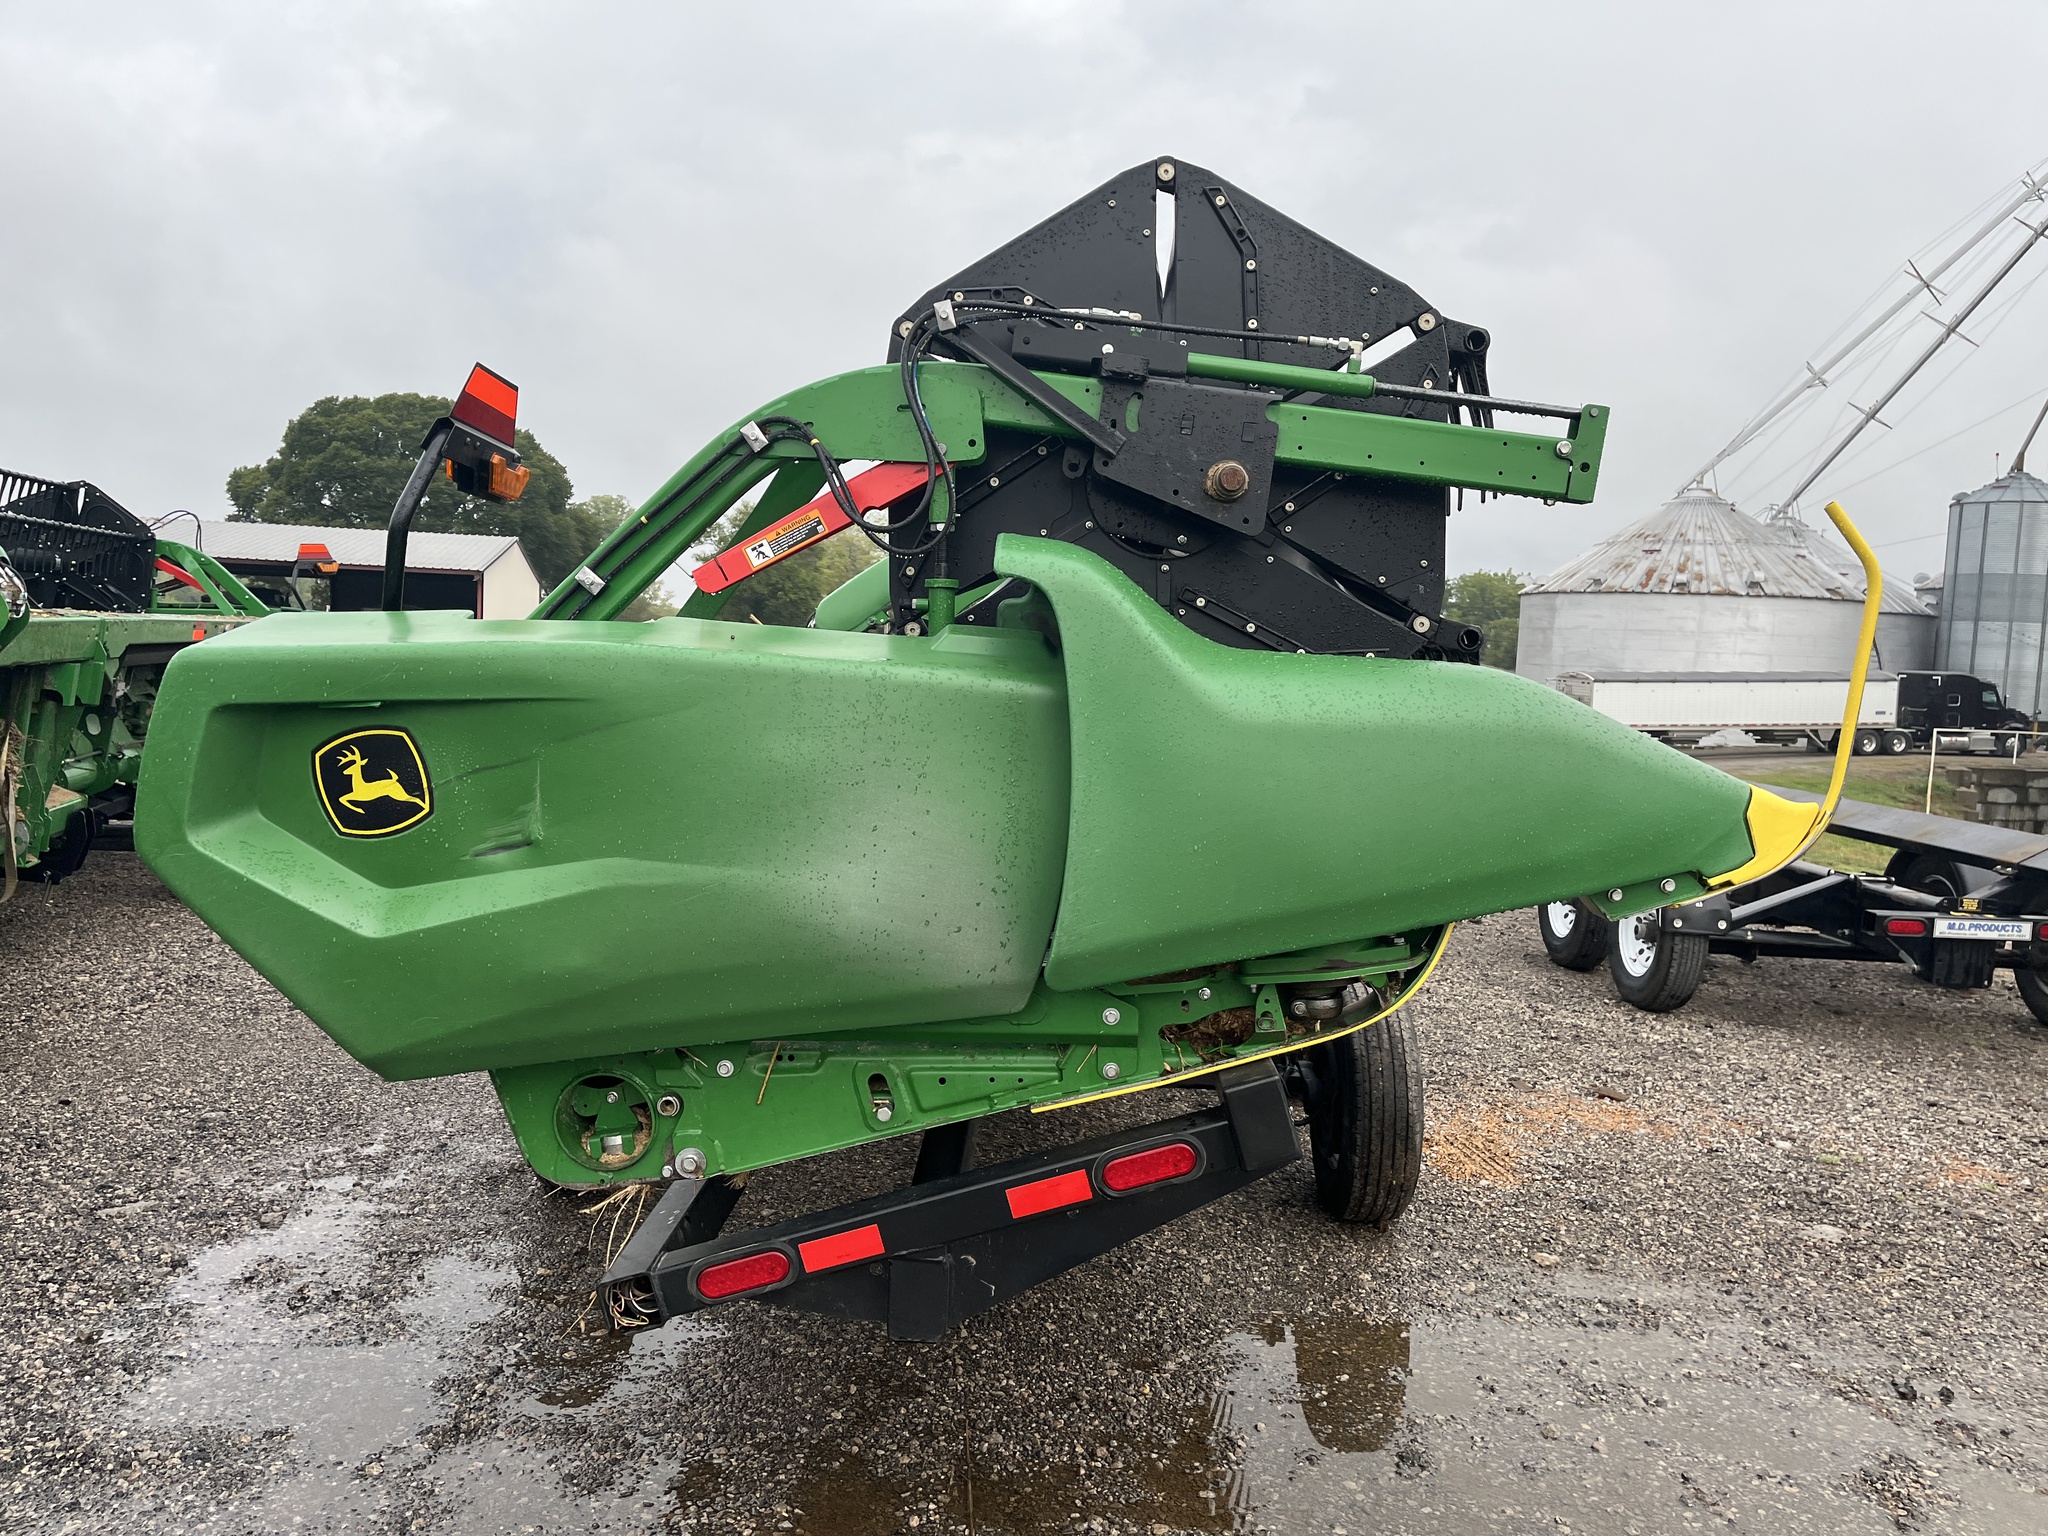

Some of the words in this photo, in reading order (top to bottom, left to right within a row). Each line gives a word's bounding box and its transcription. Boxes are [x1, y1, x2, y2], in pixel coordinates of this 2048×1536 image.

[781, 515, 811, 533] WARNING
[1947, 922, 1967, 931] M.D.
[1968, 923, 2023, 933] PRODUCTS
